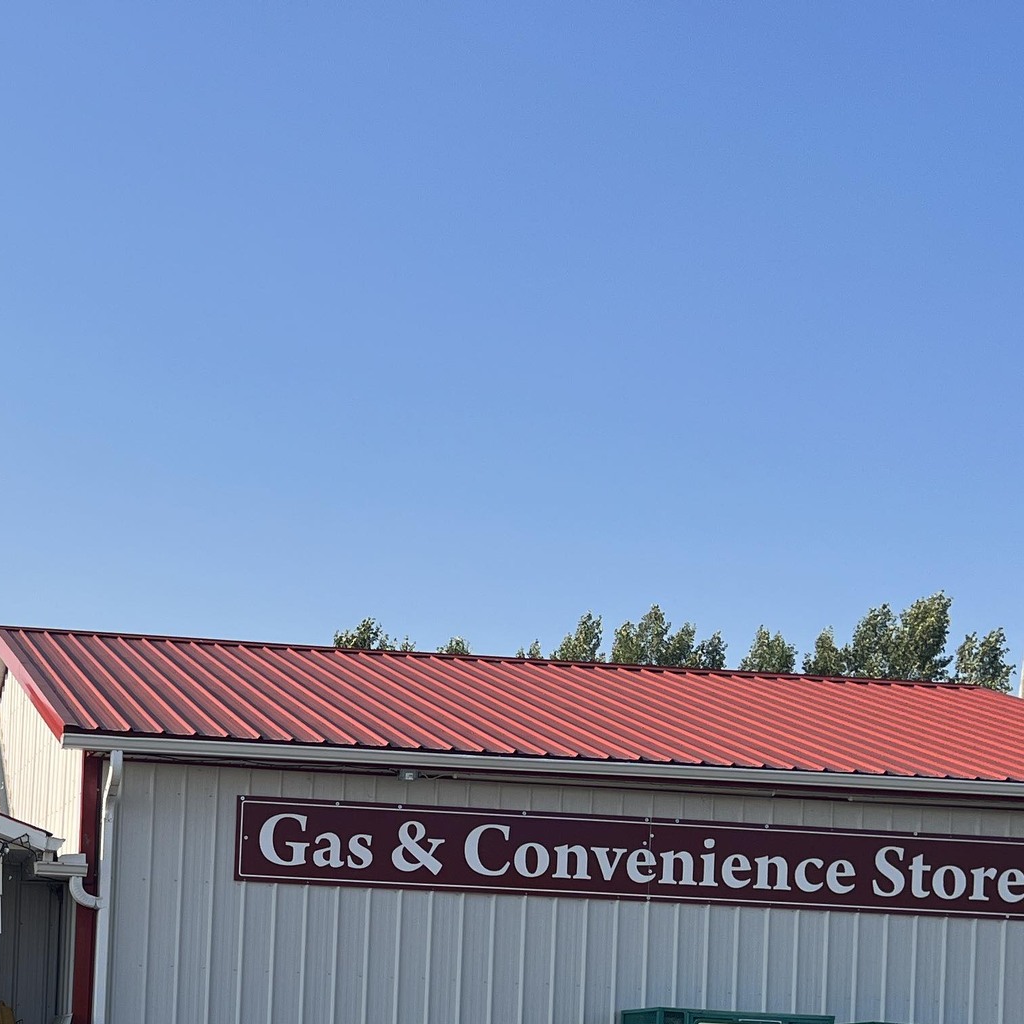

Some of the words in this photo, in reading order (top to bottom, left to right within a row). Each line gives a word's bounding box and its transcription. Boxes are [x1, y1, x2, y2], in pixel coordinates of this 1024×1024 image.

[259, 812, 373, 870] Gas
[391, 820, 445, 875] &
[464, 823, 856, 895] Convenience
[872, 845, 1024, 904] Store
